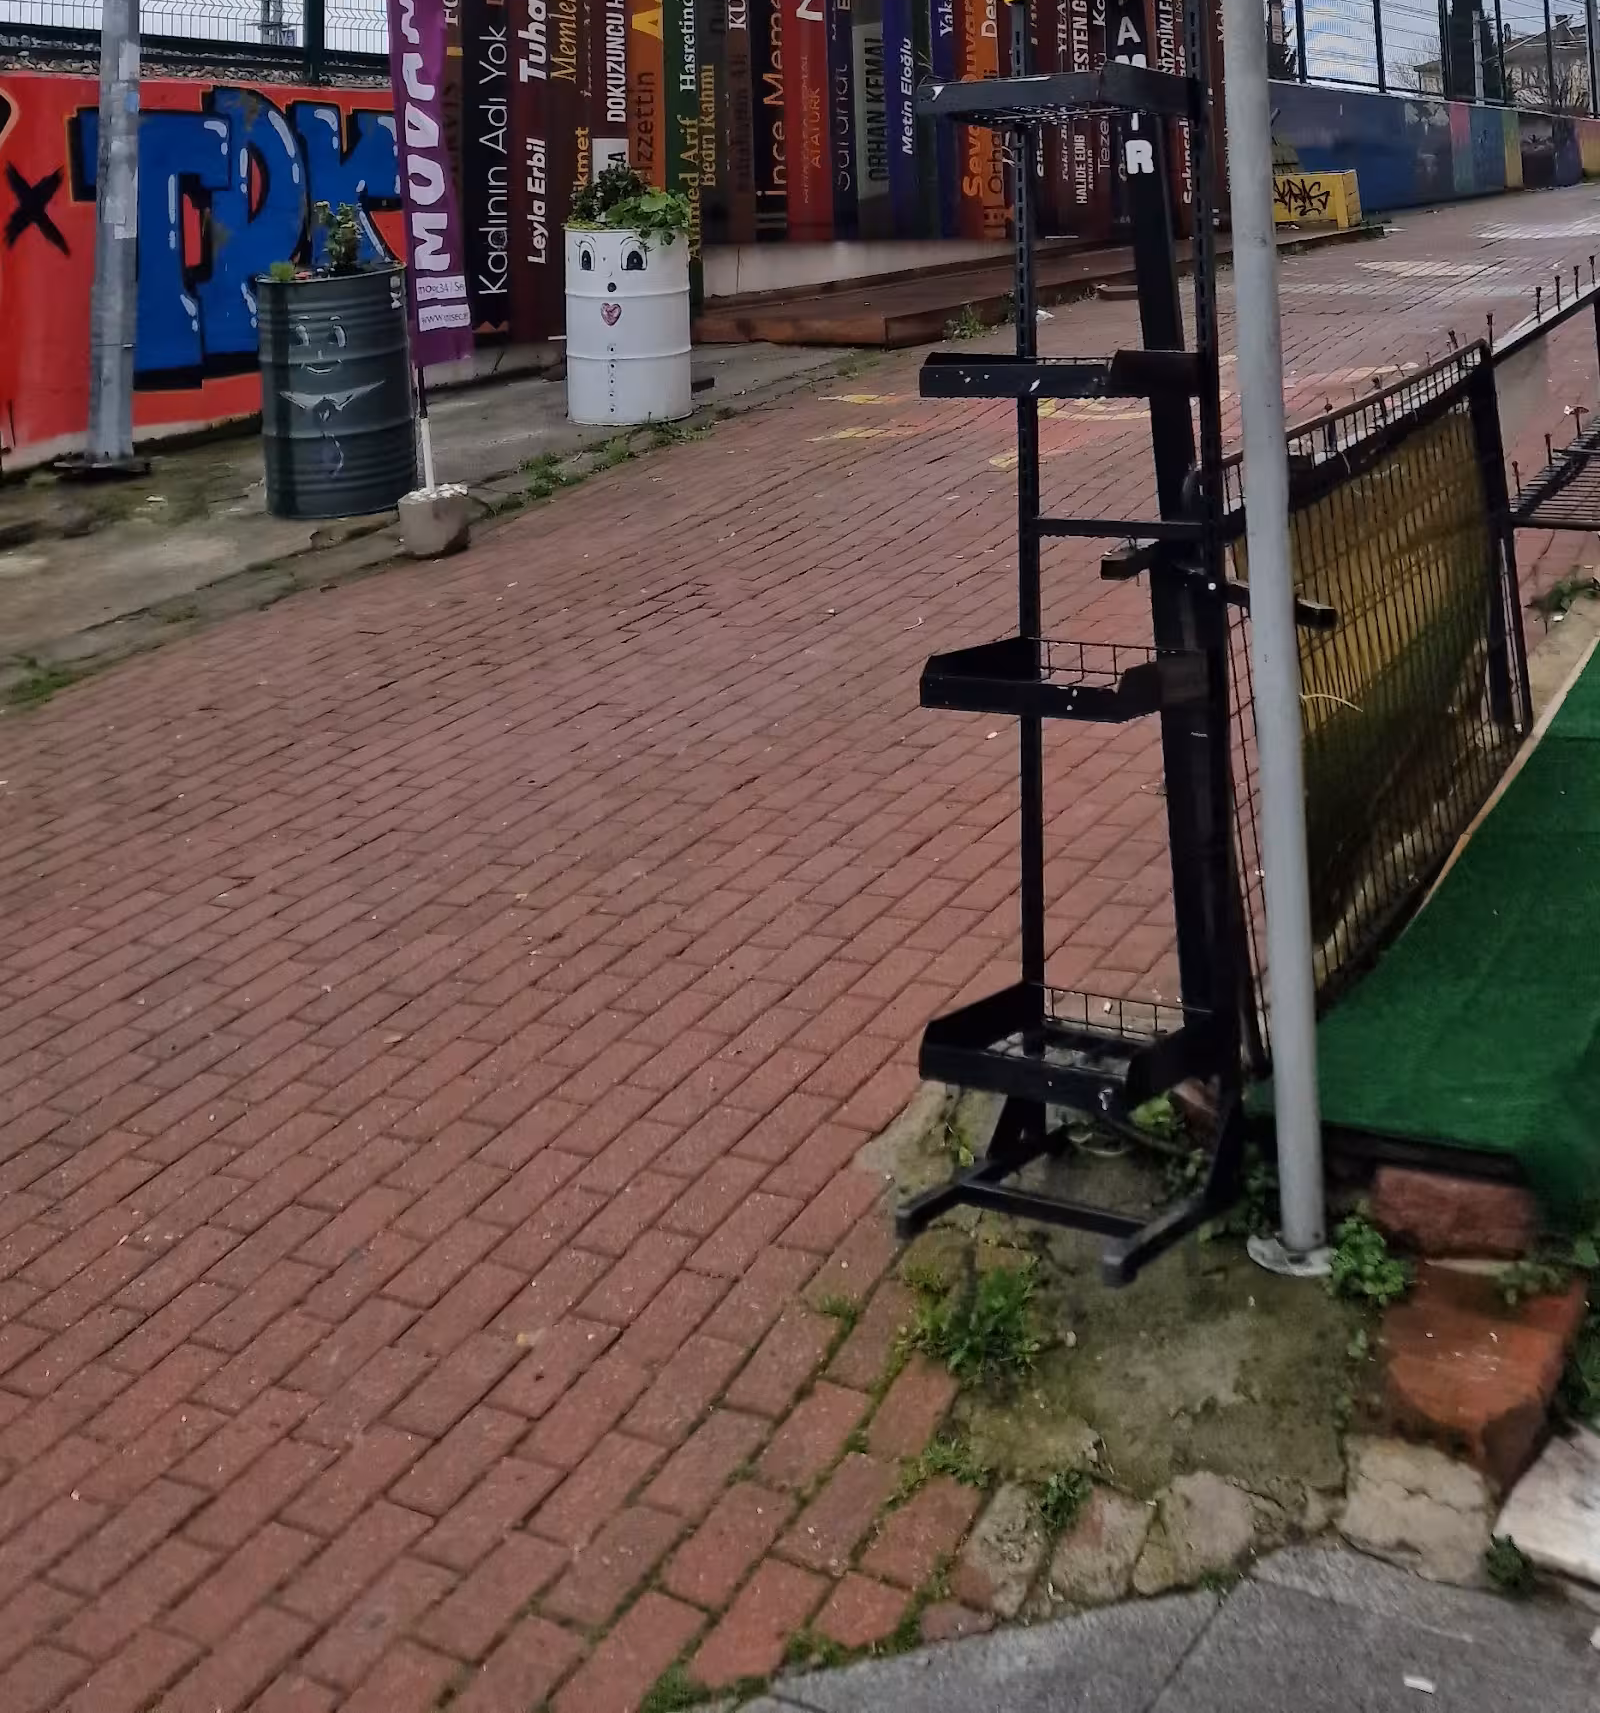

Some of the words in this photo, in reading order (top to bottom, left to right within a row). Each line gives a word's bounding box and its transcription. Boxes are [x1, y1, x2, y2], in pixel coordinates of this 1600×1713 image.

[479, 24, 507, 85] Yok
[605, 12, 627, 123] DOKUZUNCU
[899, 37, 914, 96] Eloğlu
[478, 97, 508, 155] Adı
[677, 114, 700, 165] Arif
[865, 108, 889, 183] ORHAN
[900, 100, 914, 155] Metin
[525, 137, 546, 195] Erbil
[574, 126, 590, 192] ikmet
[962, 125, 983, 197] Sev
[478, 166, 508, 295] Kadının
[526, 200, 549, 265] Leyla
